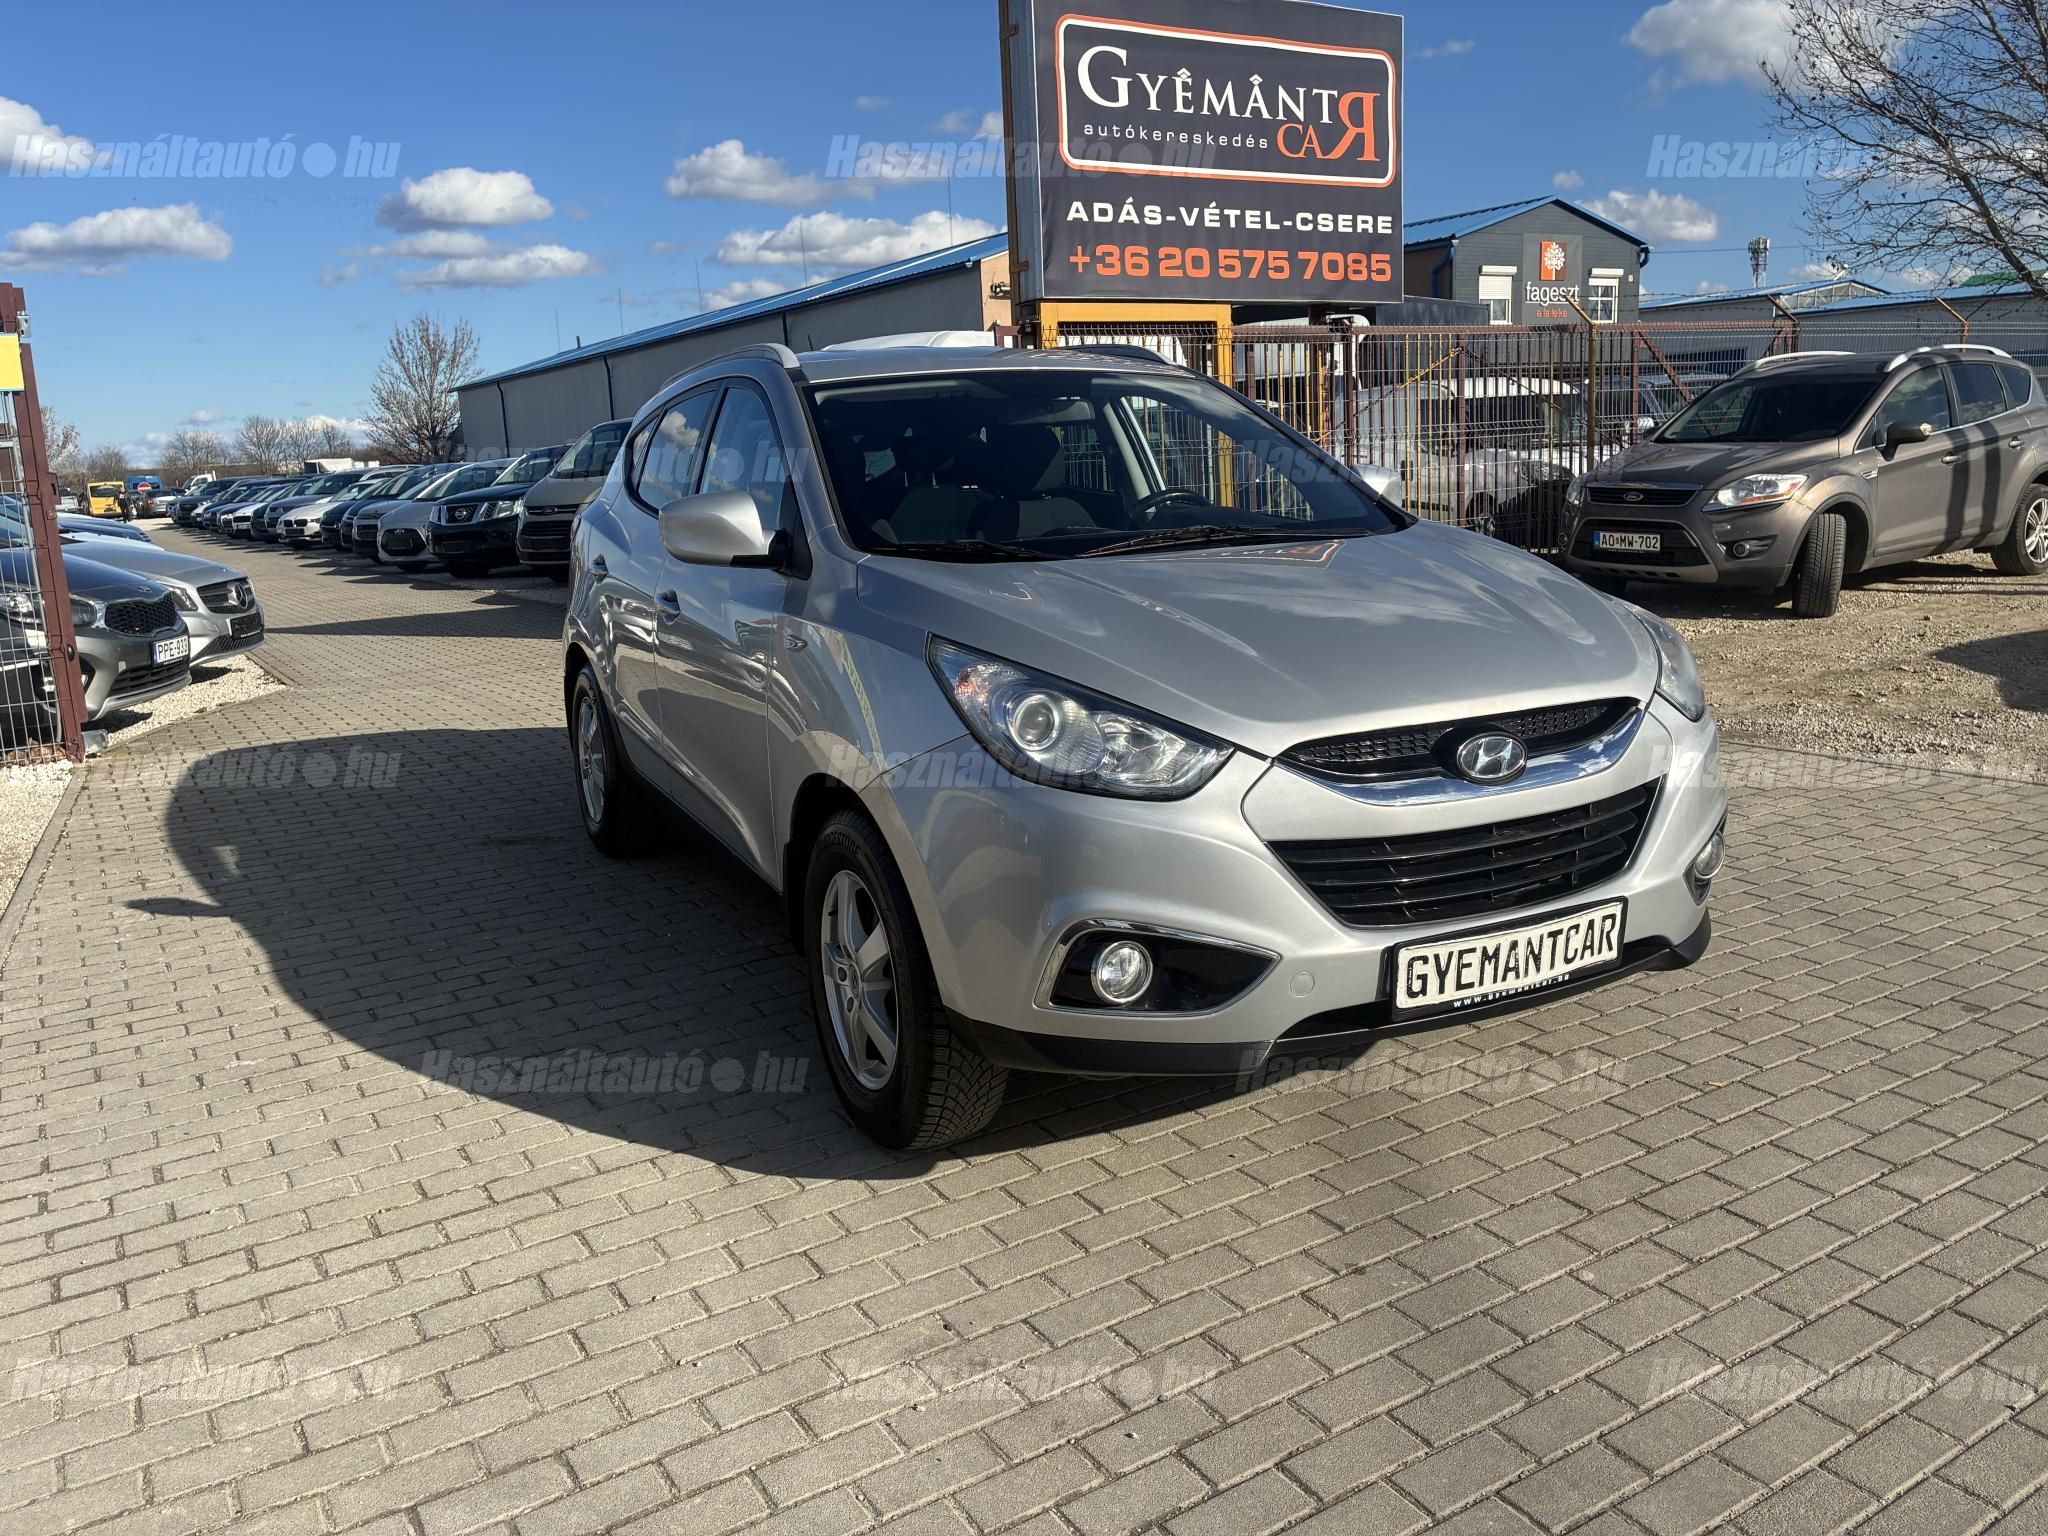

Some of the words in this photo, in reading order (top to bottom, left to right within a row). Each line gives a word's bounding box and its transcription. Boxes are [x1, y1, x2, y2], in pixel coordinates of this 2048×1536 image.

[1083, 123, 1269, 149] autókereskedés
[1066, 196, 1393, 235] ADÁS-VÉTEL-CSERE
[1069, 244, 1150, 277] +36
[1158, 247, 1211, 278] 20
[1218, 248, 1290, 280] 575
[1297, 251, 1392, 282] 7085
[1526, 281, 1580, 307] fageszt
[157, 637, 188, 661] PPE-933
[1405, 912, 1618, 999] GYEMANTCAR
